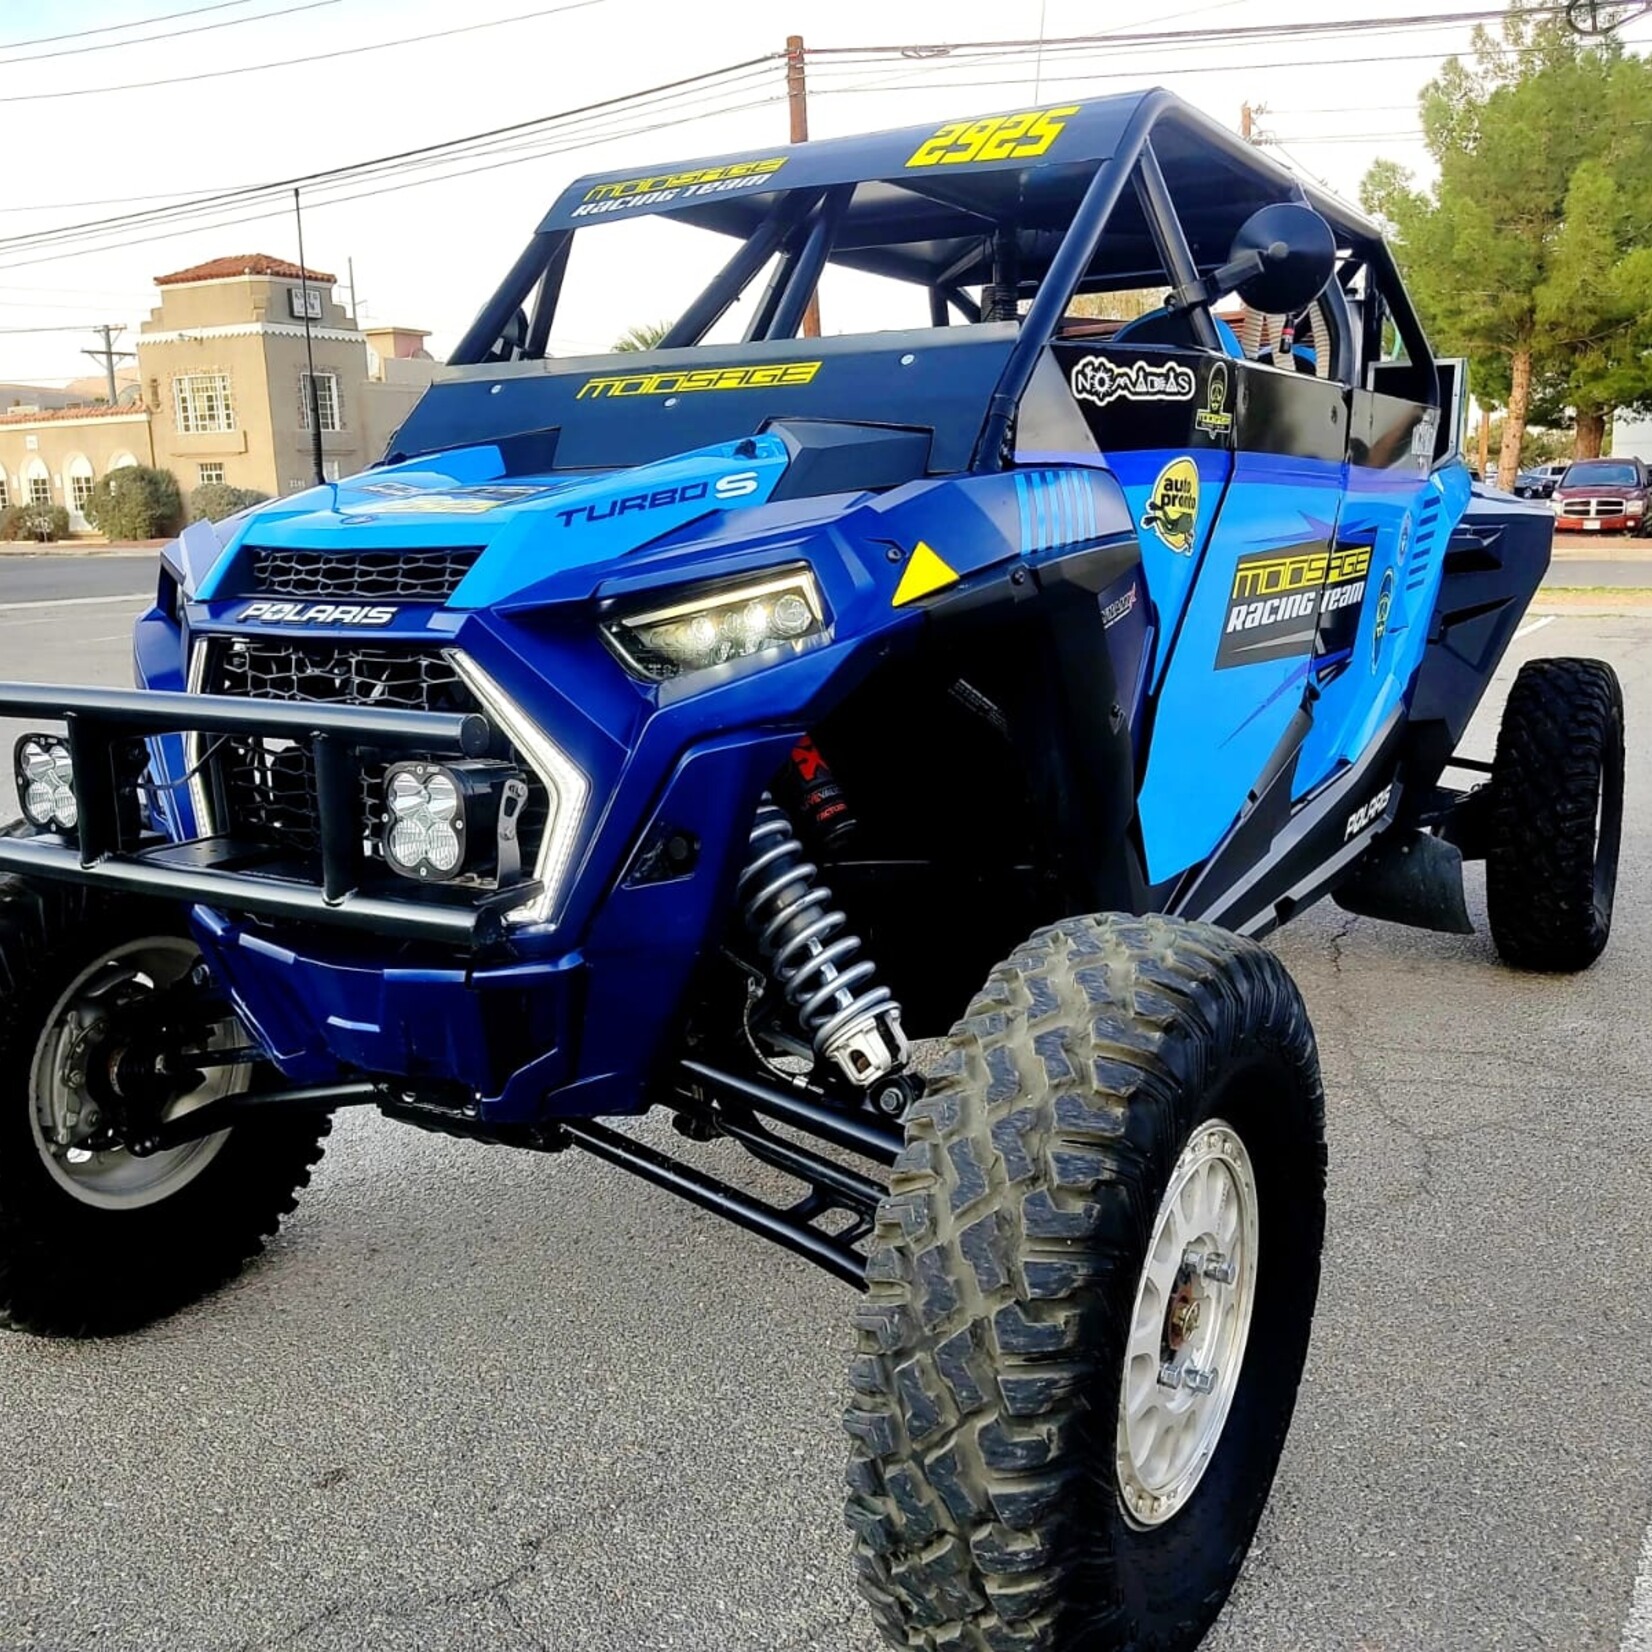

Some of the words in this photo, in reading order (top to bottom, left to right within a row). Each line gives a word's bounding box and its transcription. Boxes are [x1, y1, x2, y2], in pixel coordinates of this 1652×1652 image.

[904, 105, 1081, 168] 2925
[555, 481, 708, 528] TURBO
[714, 471, 759, 499] S
[236, 603, 400, 626] POLARIS
[1344, 783, 1393, 841] POLARIS
